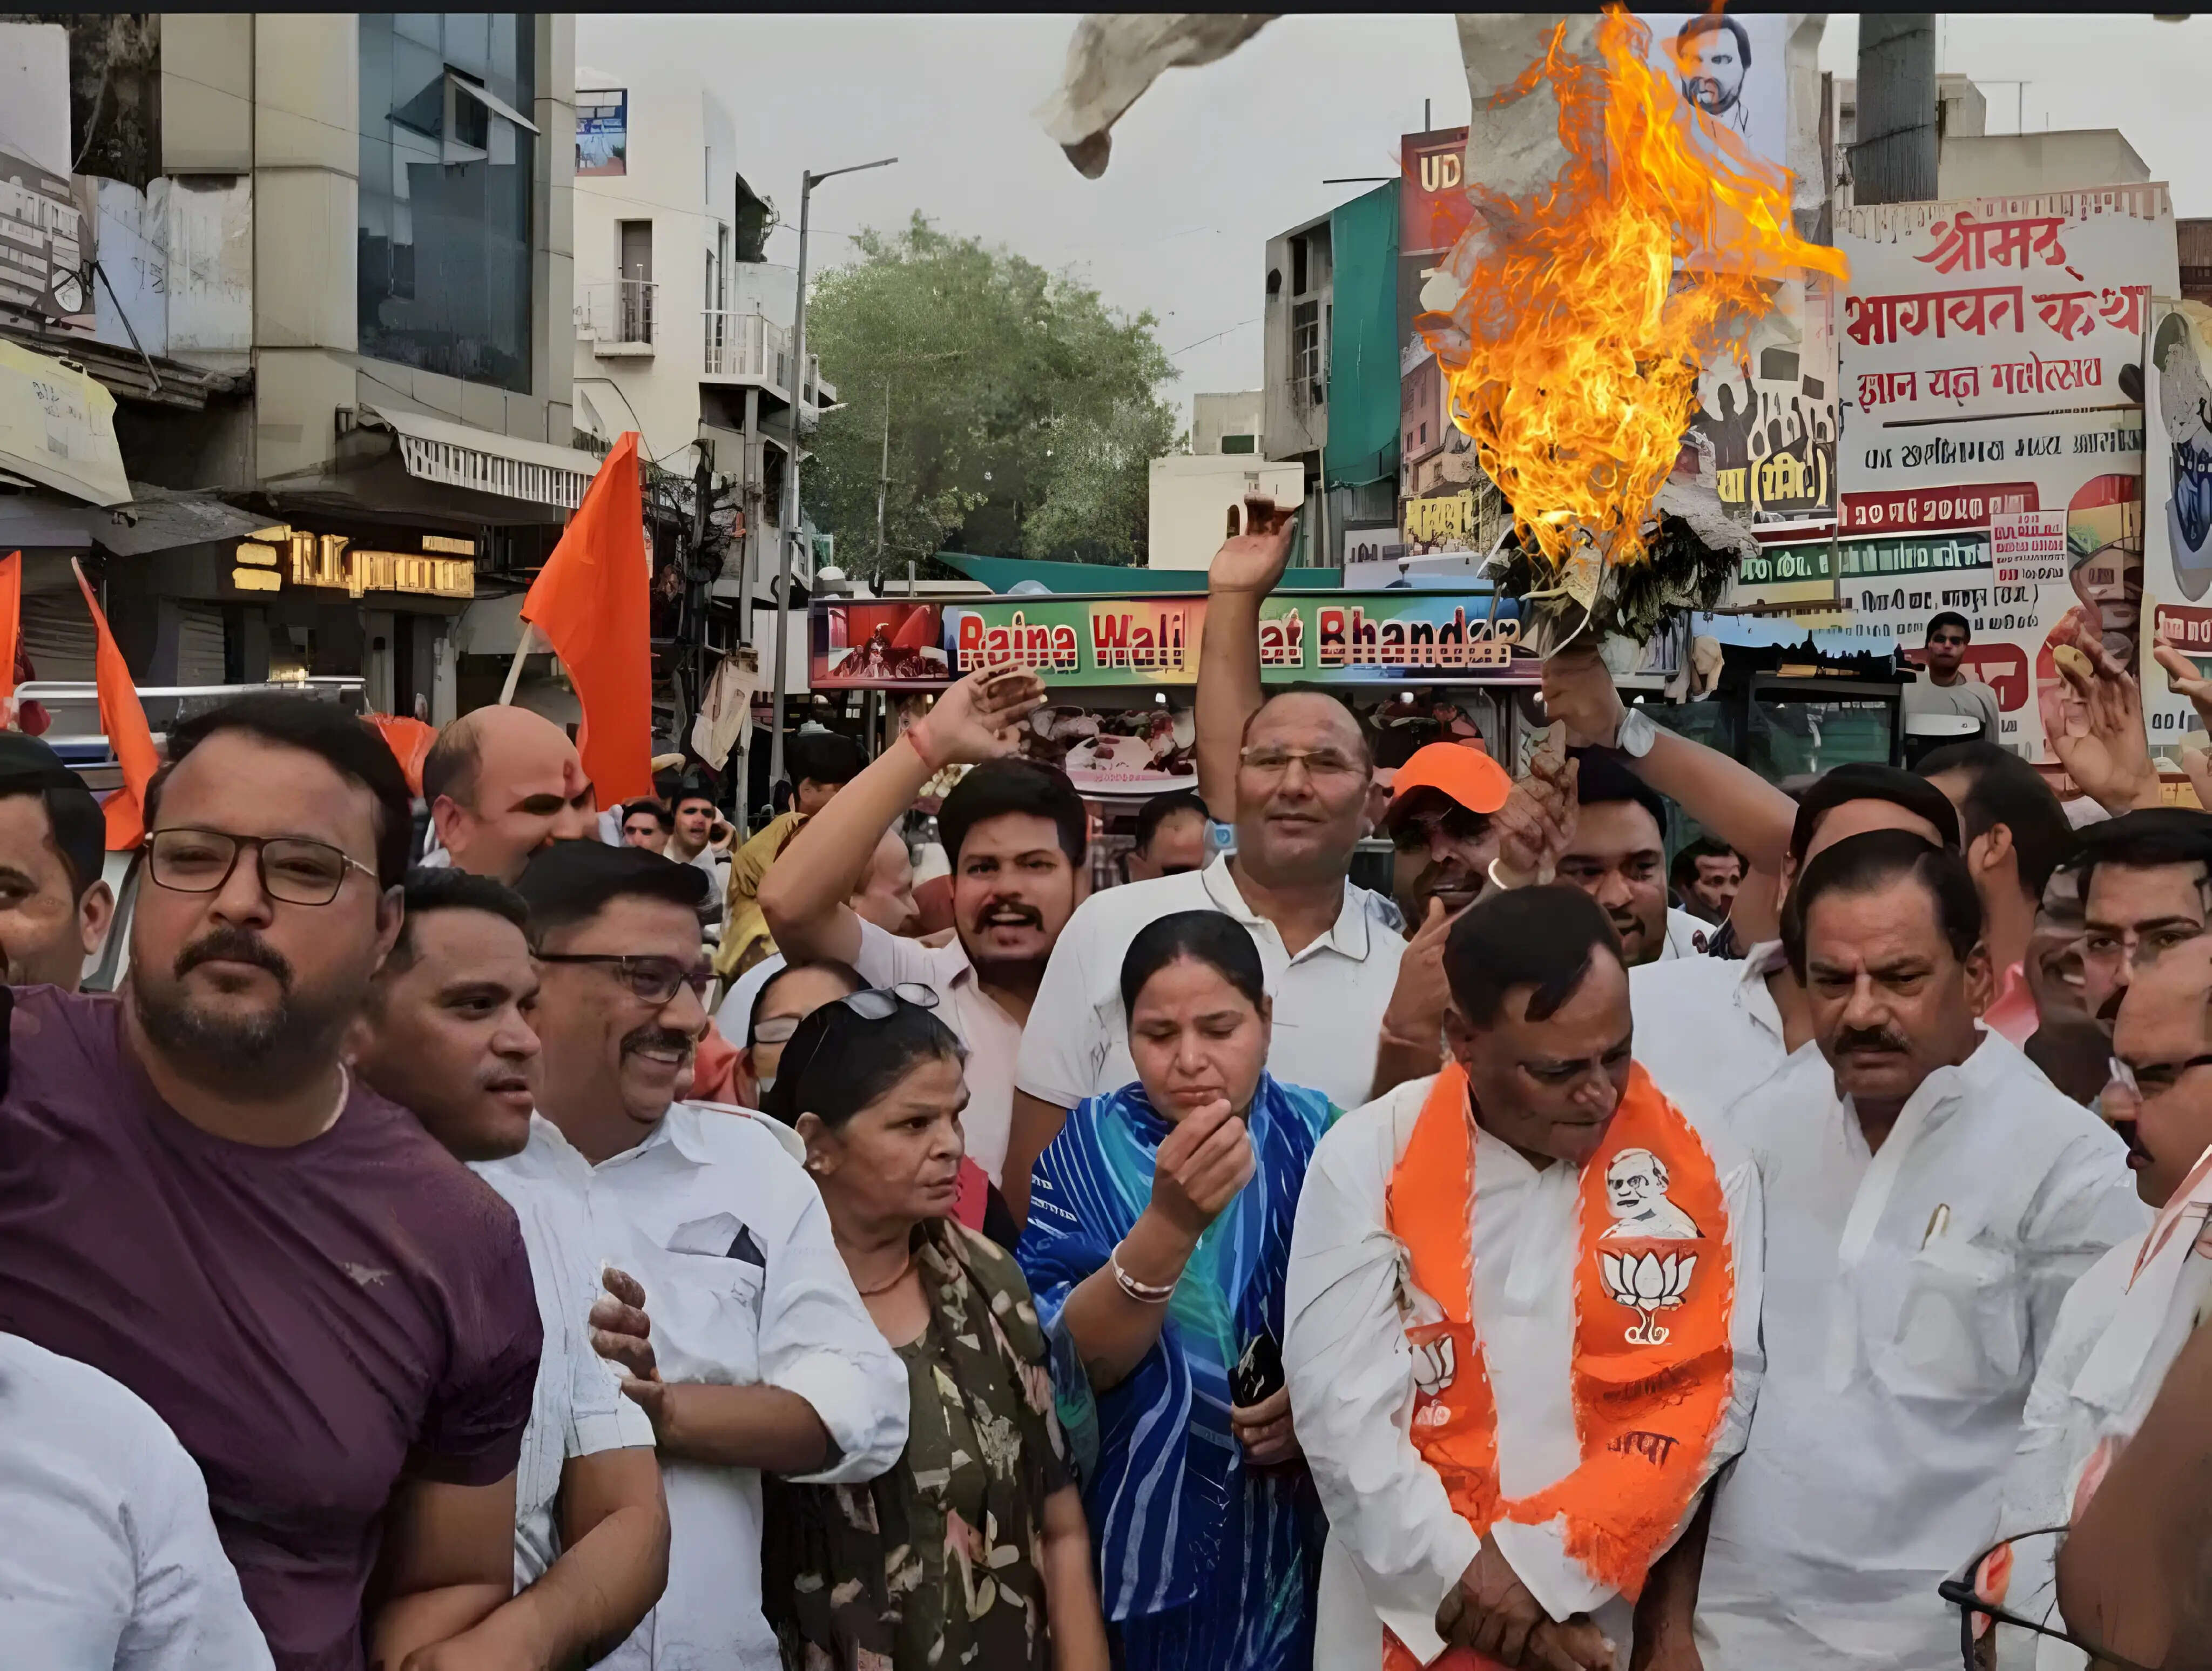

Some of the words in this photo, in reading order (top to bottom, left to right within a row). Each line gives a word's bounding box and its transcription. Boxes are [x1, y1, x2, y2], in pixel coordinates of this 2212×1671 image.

[1845, 285, 2024, 346] भागवत
[1091, 610, 1185, 673] Wali
[1317, 605, 1521, 669] Bhandar
